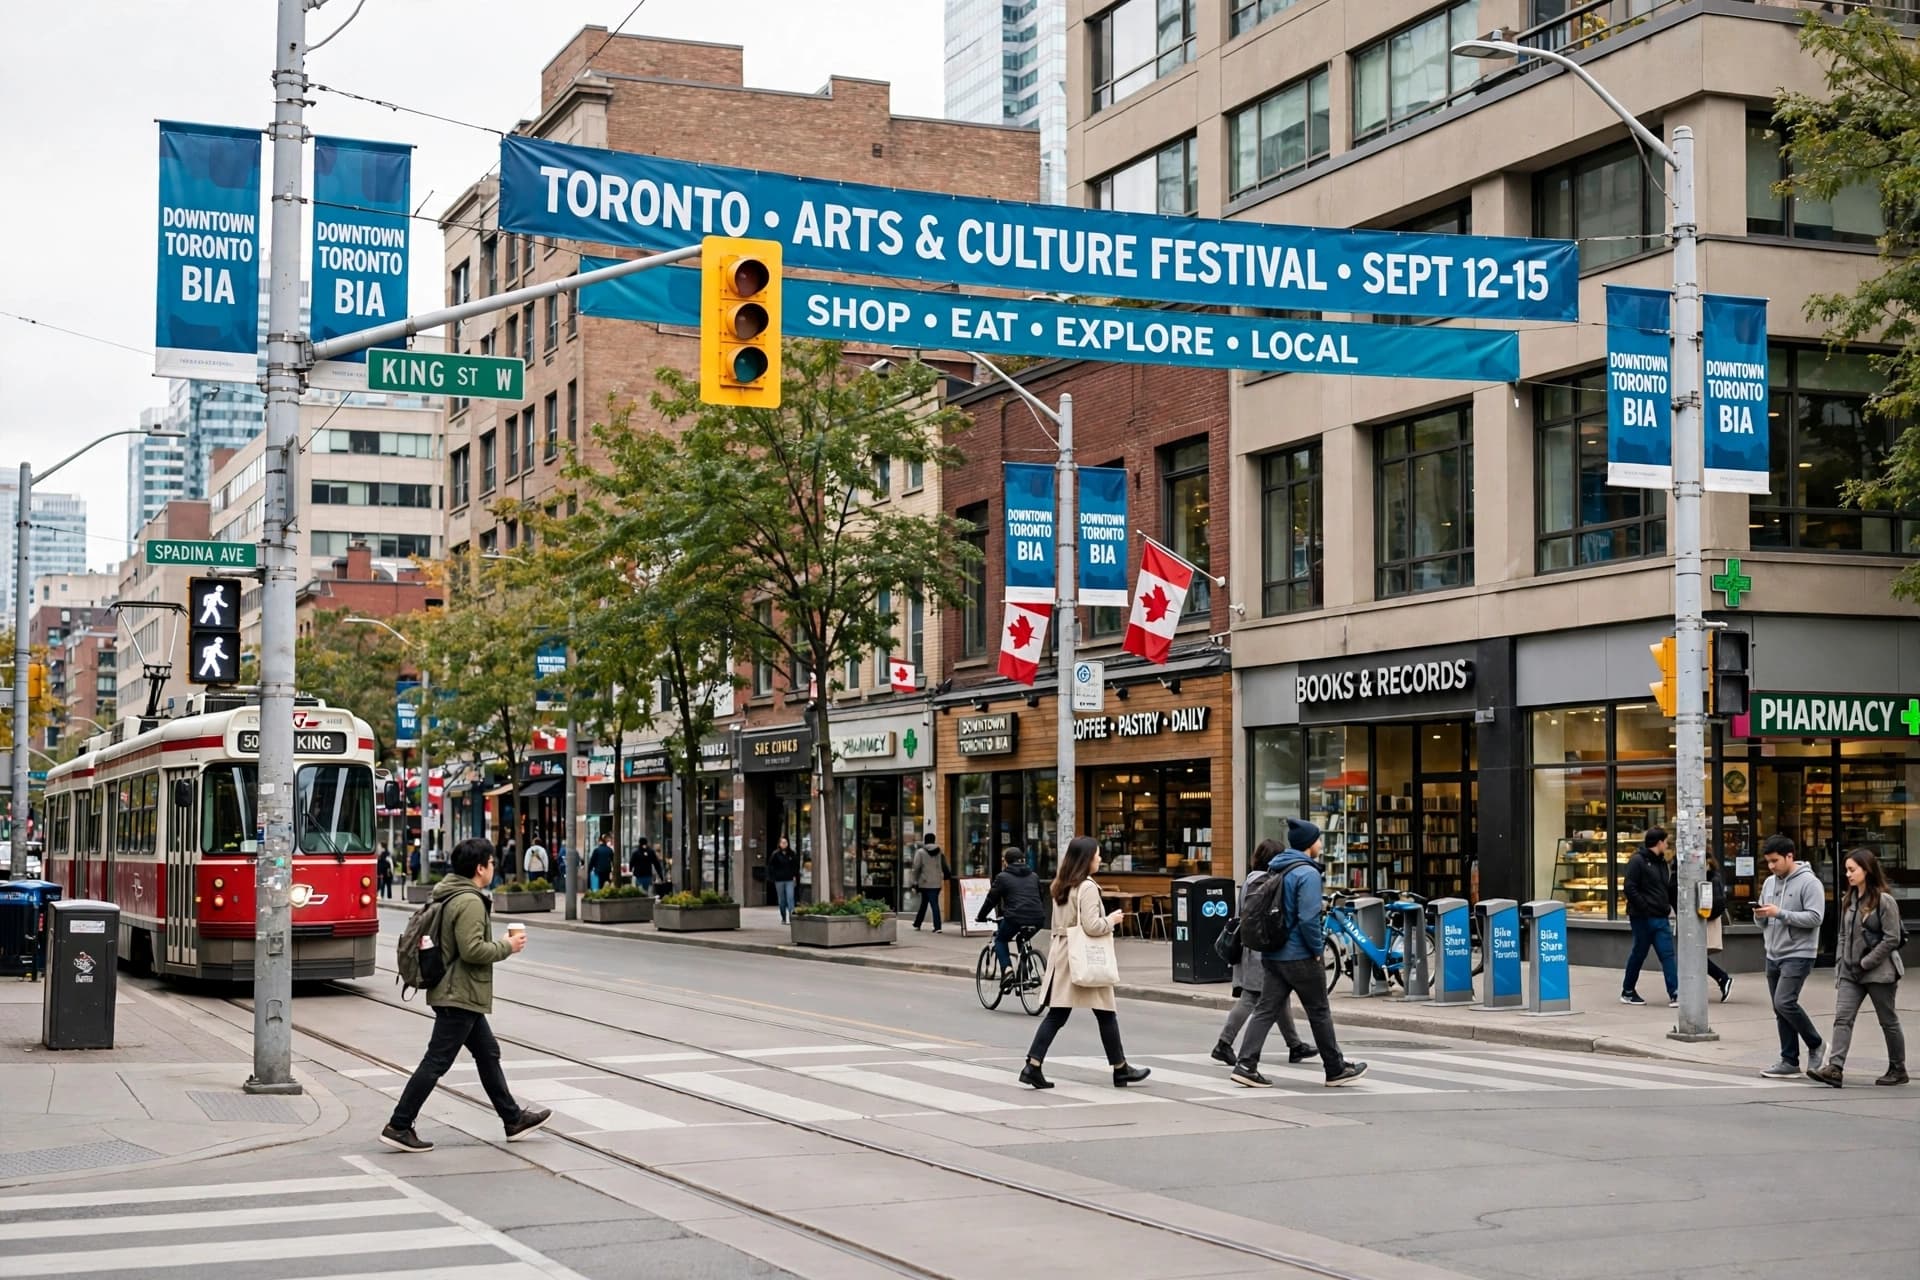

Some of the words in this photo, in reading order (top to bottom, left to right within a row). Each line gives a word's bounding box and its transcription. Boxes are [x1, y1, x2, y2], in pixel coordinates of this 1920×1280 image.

[163, 207, 255, 235] DOWNTOWN
[317, 221, 405, 249] DOWNTOWN
[540, 166, 750, 237] TORONTO
[792, 200, 903, 256] ARTS
[915, 214, 946, 261] &
[957, 219, 1138, 278] CULTURE
[1151, 238, 1328, 291] FESTIVAL
[1362, 251, 1454, 297] SEPT
[1462, 257, 1549, 301] 12-15
[165, 231, 254, 262] TORONTO
[319, 246, 403, 276] TORONTO
[182, 264, 236, 305] BIA
[334, 278, 386, 317] BIA
[807, 294, 911, 333] SHOP
[951, 307, 1019, 342] EAT
[1056, 316, 1215, 356] EXPLORE
[1251, 330, 1359, 364] LOCAL
[1610, 351, 1668, 373] DOWNTOWN
[1706, 360, 1764, 380] DOWNTOWN
[382, 358, 445, 387] KING
[457, 367, 479, 386] ST
[496, 368, 512, 392] W
[1612, 371, 1667, 394] TORONTO
[1708, 379, 1763, 402] TORONTO
[1623, 397, 1658, 428] BIA
[1719, 404, 1754, 435] BIA
[1008, 508, 1052, 522] DOWNTOWN
[1080, 512, 1125, 526] DOWNTOWN
[1009, 522, 1052, 538] TORONTO
[1082, 526, 1125, 541] TORONTO
[154, 544, 214, 562] SPADINA
[220, 547, 245, 563] AVE
[1017, 541, 1044, 562] BIA
[1090, 544, 1117, 565] BIA
[1296, 671, 1355, 703] BOOKS
[1359, 669, 1373, 698] &
[1377, 658, 1468, 696] RECORDS
[1118, 711, 1160, 736] PASTRY
[1171, 706, 1206, 732] DAILY
[1760, 698, 1895, 732] PHARMACY
[296, 735, 332, 750] KING
[1444, 937, 1466, 946] Share
[1494, 939, 1516, 948] Share
[1540, 930, 1558, 940] Bike
[1541, 941, 1563, 951] Share
[1541, 953, 1566, 962] Toronto
